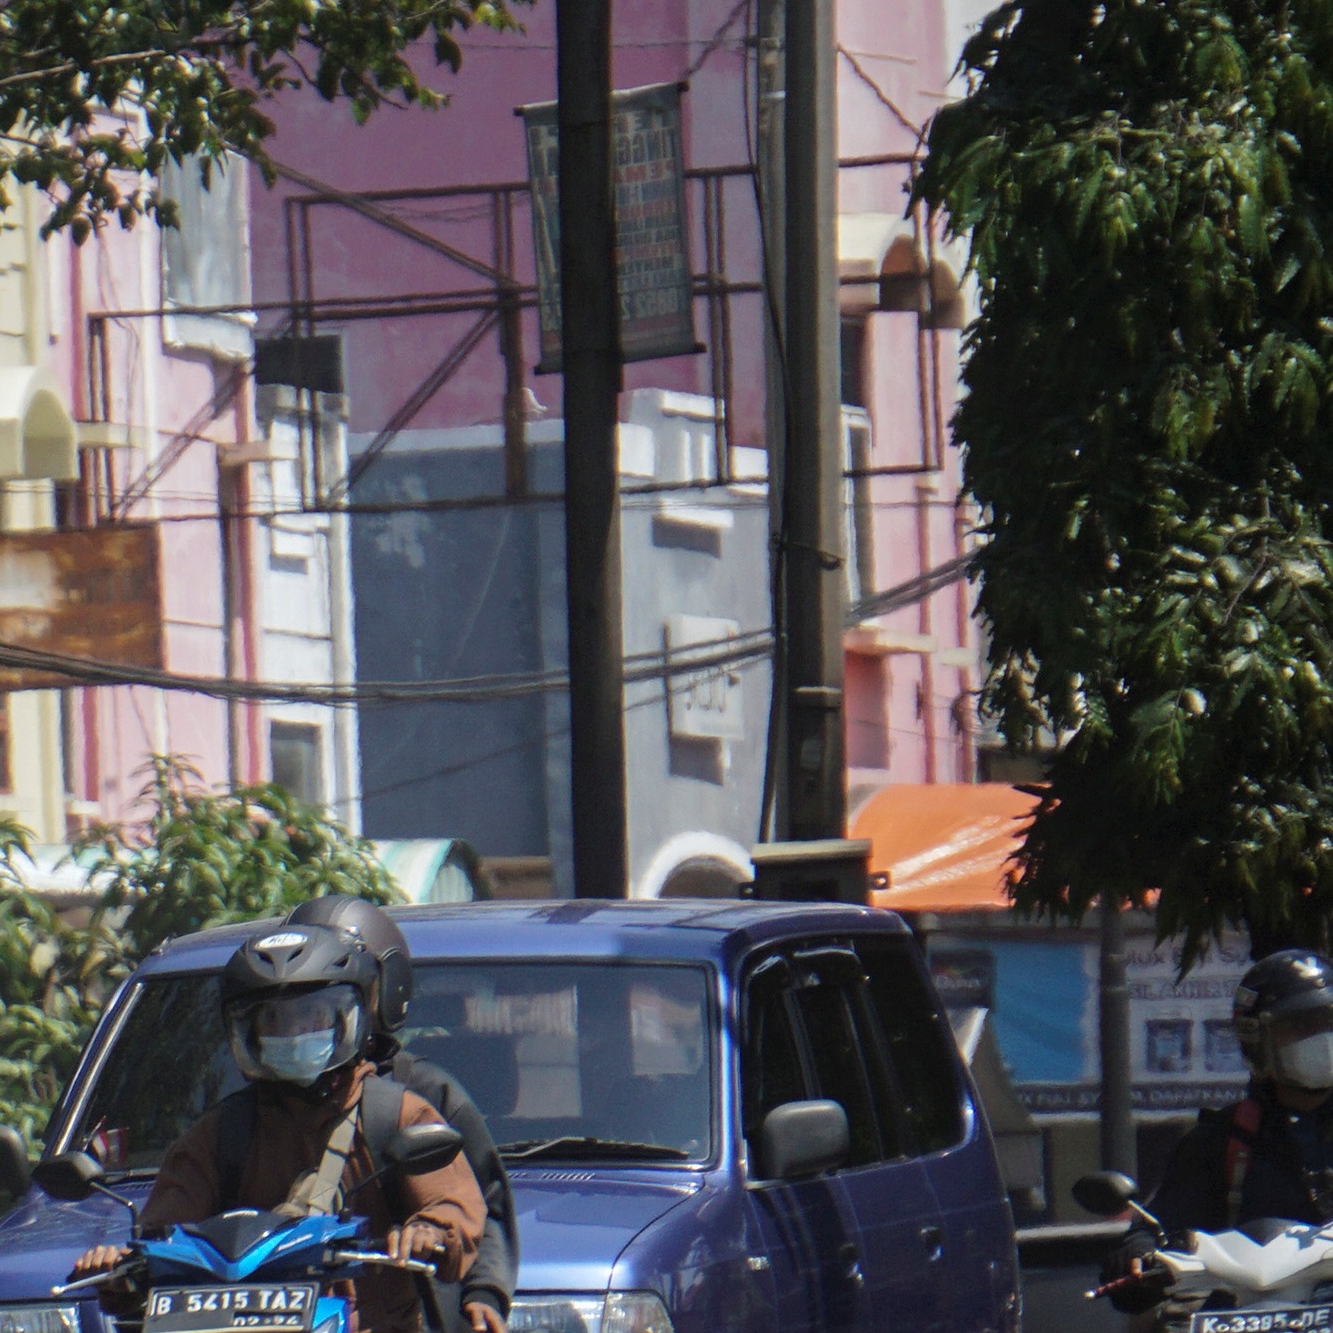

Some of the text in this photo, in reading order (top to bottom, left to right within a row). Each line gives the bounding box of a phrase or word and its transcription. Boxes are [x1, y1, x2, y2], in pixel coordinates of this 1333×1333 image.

[157, 1290, 306, 1315] B 5415 TAZ
[1301, 1308, 1331, 1327] DE
